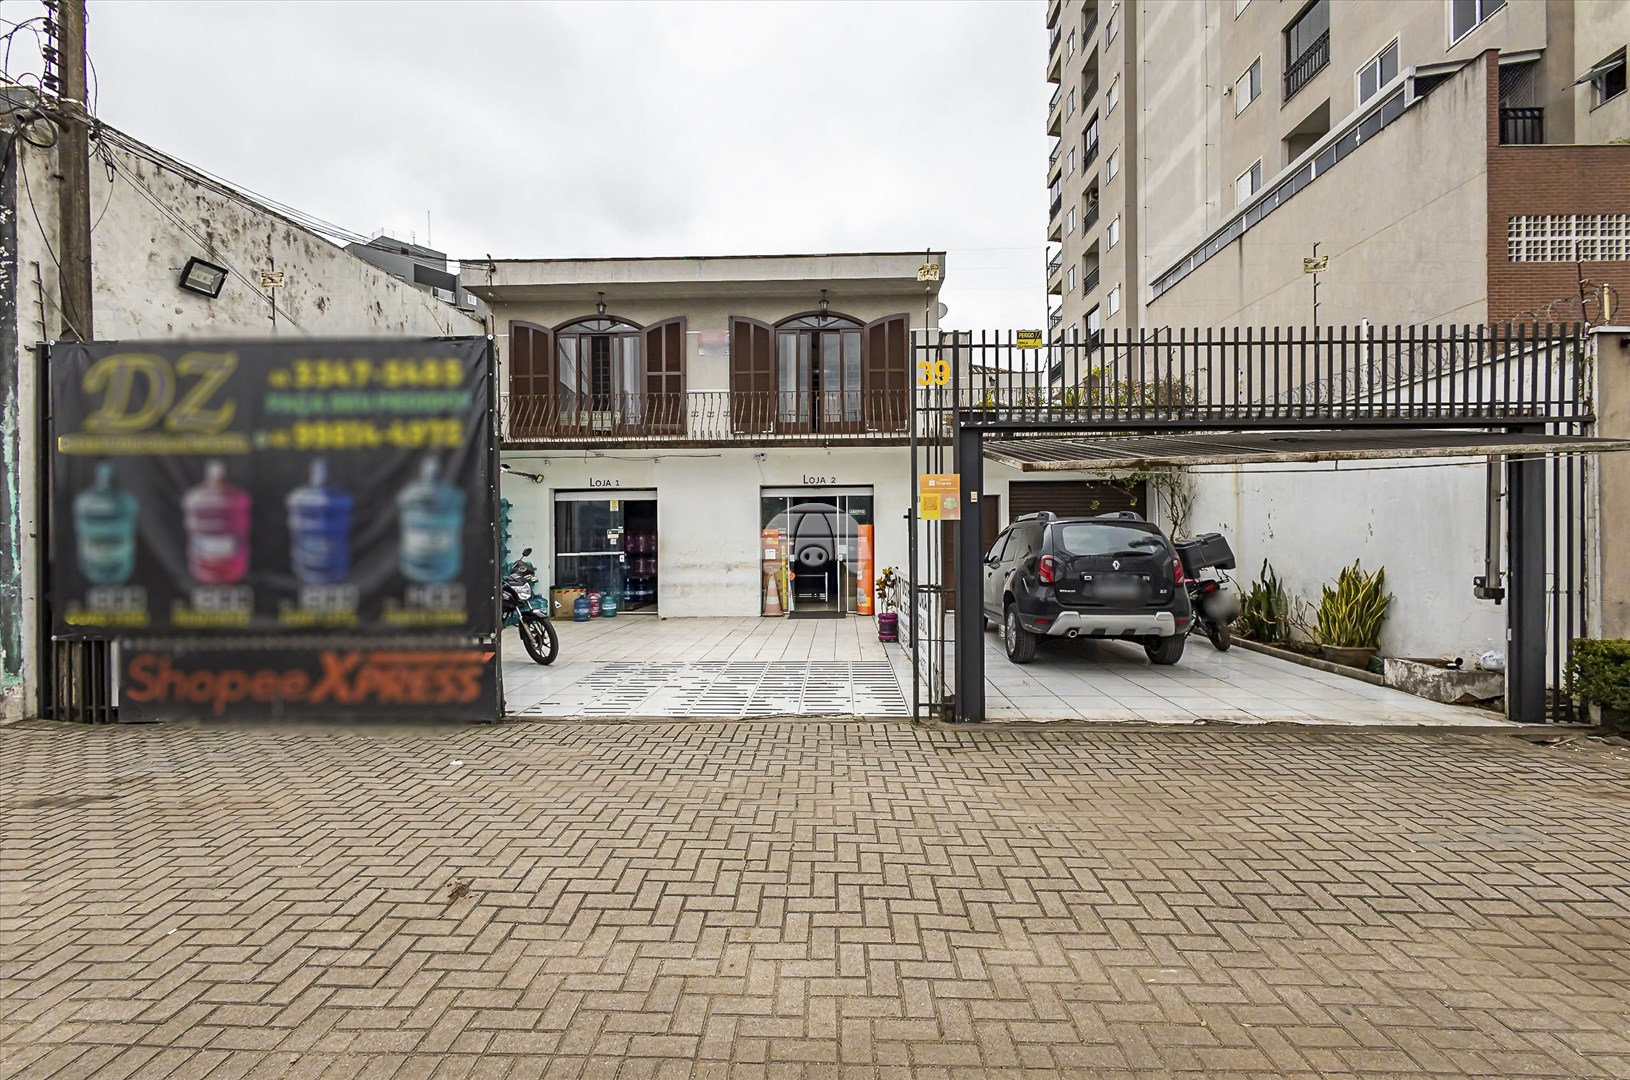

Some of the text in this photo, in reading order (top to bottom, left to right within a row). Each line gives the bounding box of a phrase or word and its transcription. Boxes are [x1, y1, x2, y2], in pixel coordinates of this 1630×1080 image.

[918, 359, 951, 386] 39
[82, 350, 239, 436] DZ
[589, 477, 620, 487] LOJA 1
[804, 474, 836, 484] LOJA 2
[126, 653, 308, 716] Shopee
